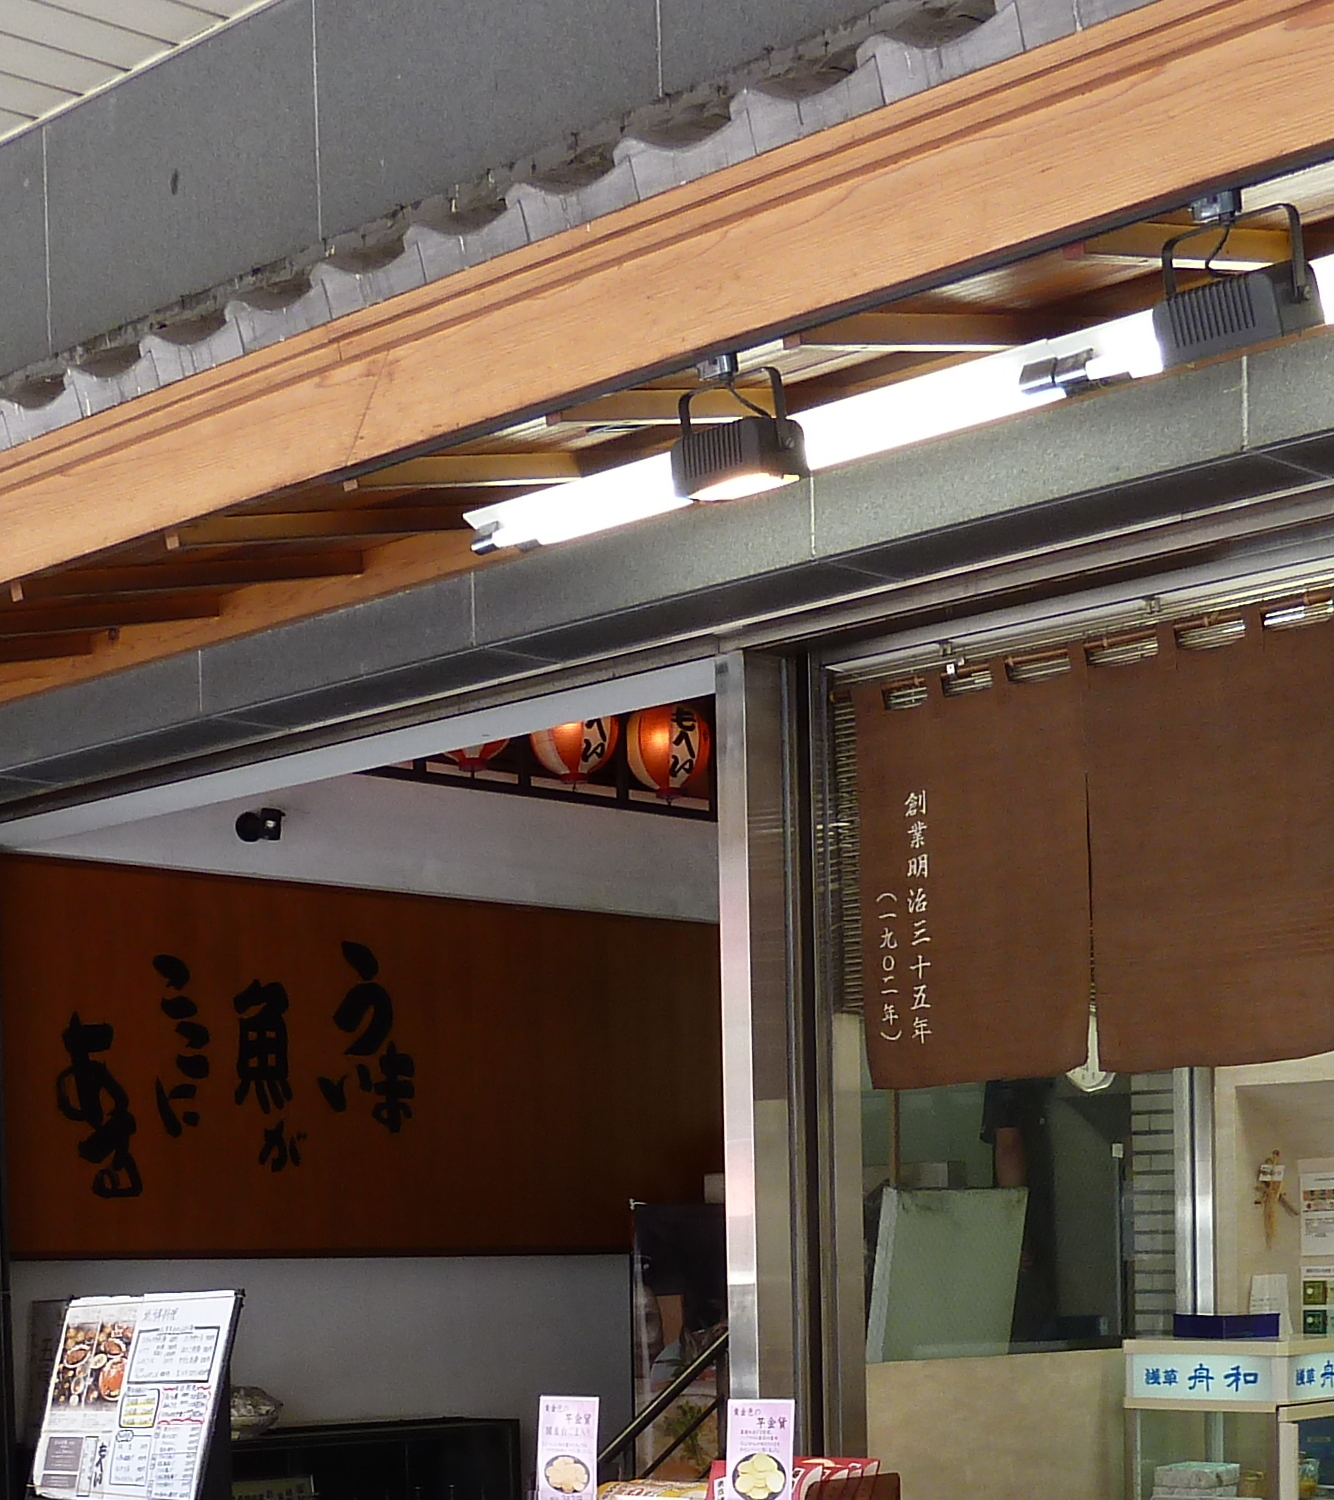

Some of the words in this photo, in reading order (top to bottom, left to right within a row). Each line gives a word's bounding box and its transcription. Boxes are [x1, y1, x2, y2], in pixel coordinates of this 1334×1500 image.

[904, 789, 933, 1045] 創業明治三十五年
[232, 978, 308, 1173] 魚が
[1185, 1360, 1260, 1394] 舟和
